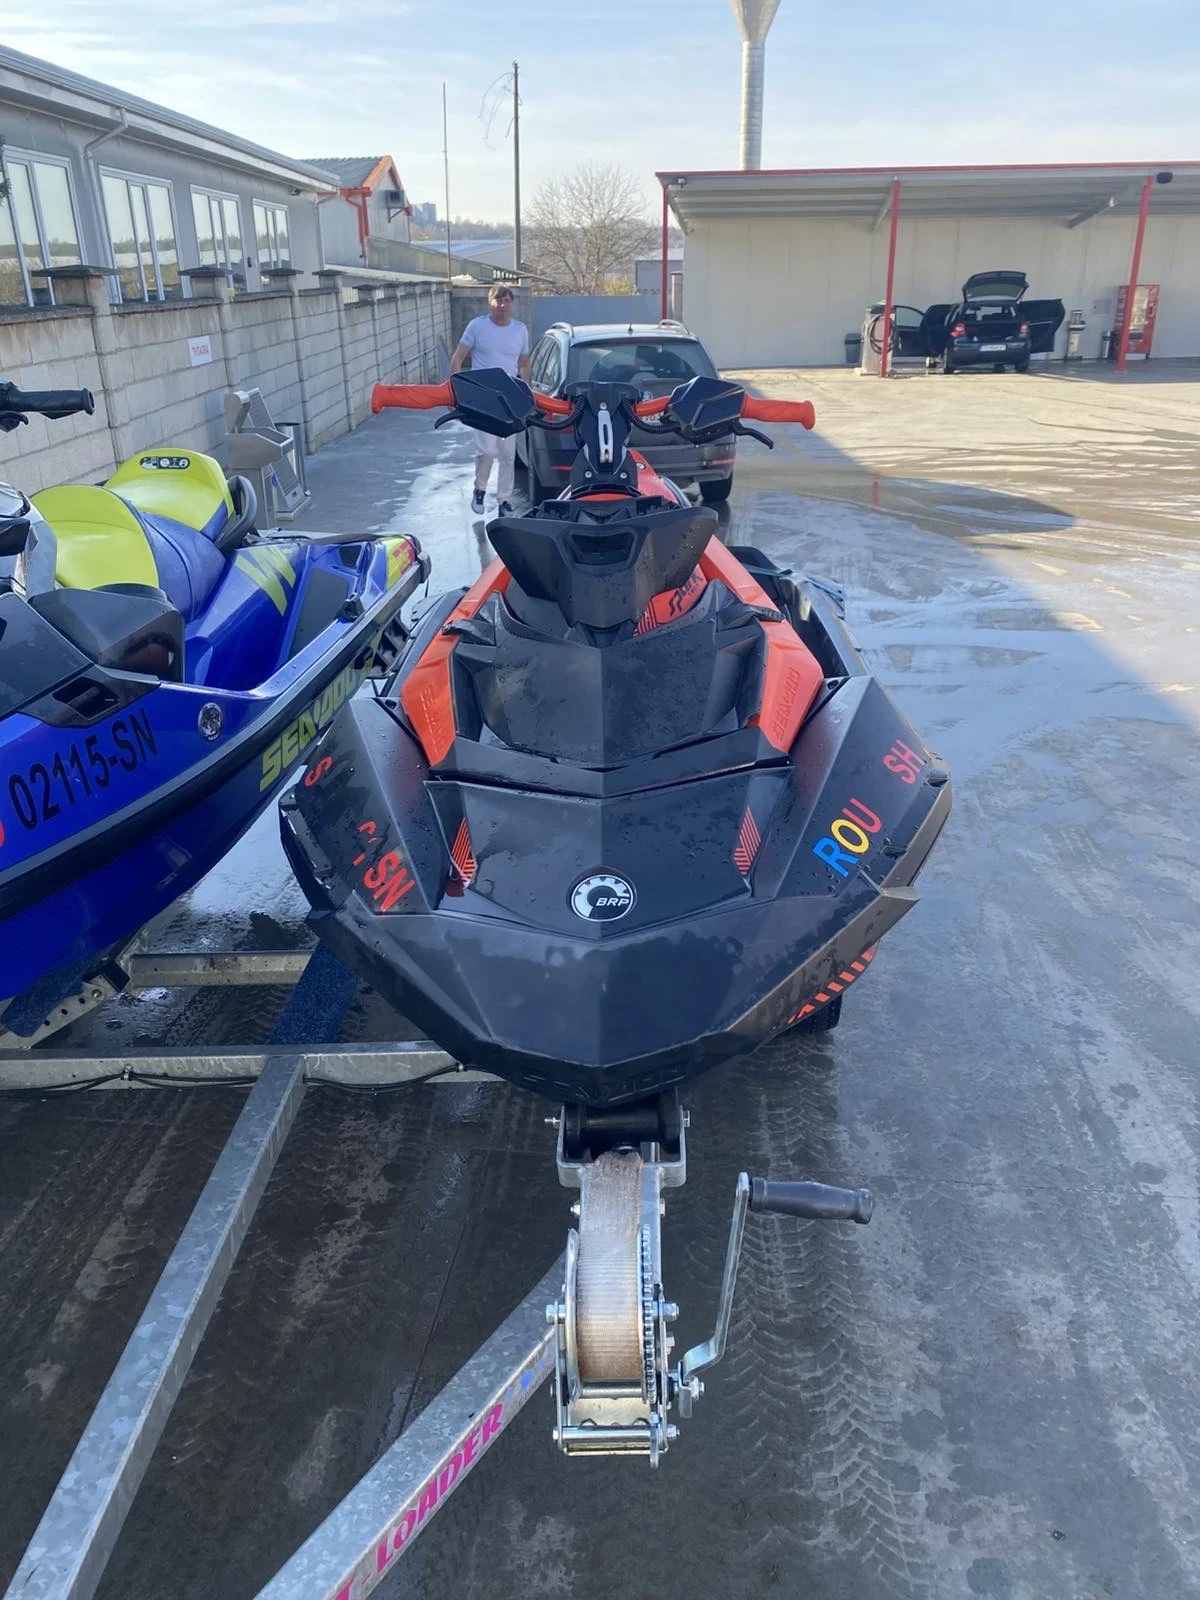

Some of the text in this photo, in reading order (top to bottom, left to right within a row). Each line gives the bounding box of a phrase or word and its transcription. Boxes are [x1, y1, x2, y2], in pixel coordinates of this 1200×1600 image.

[8, 708, 158, 831] 02115-SN
[812, 739, 925, 878] ROU SH
[363, 851, 415, 913] SN
[595, 897, 630, 907] BRP
